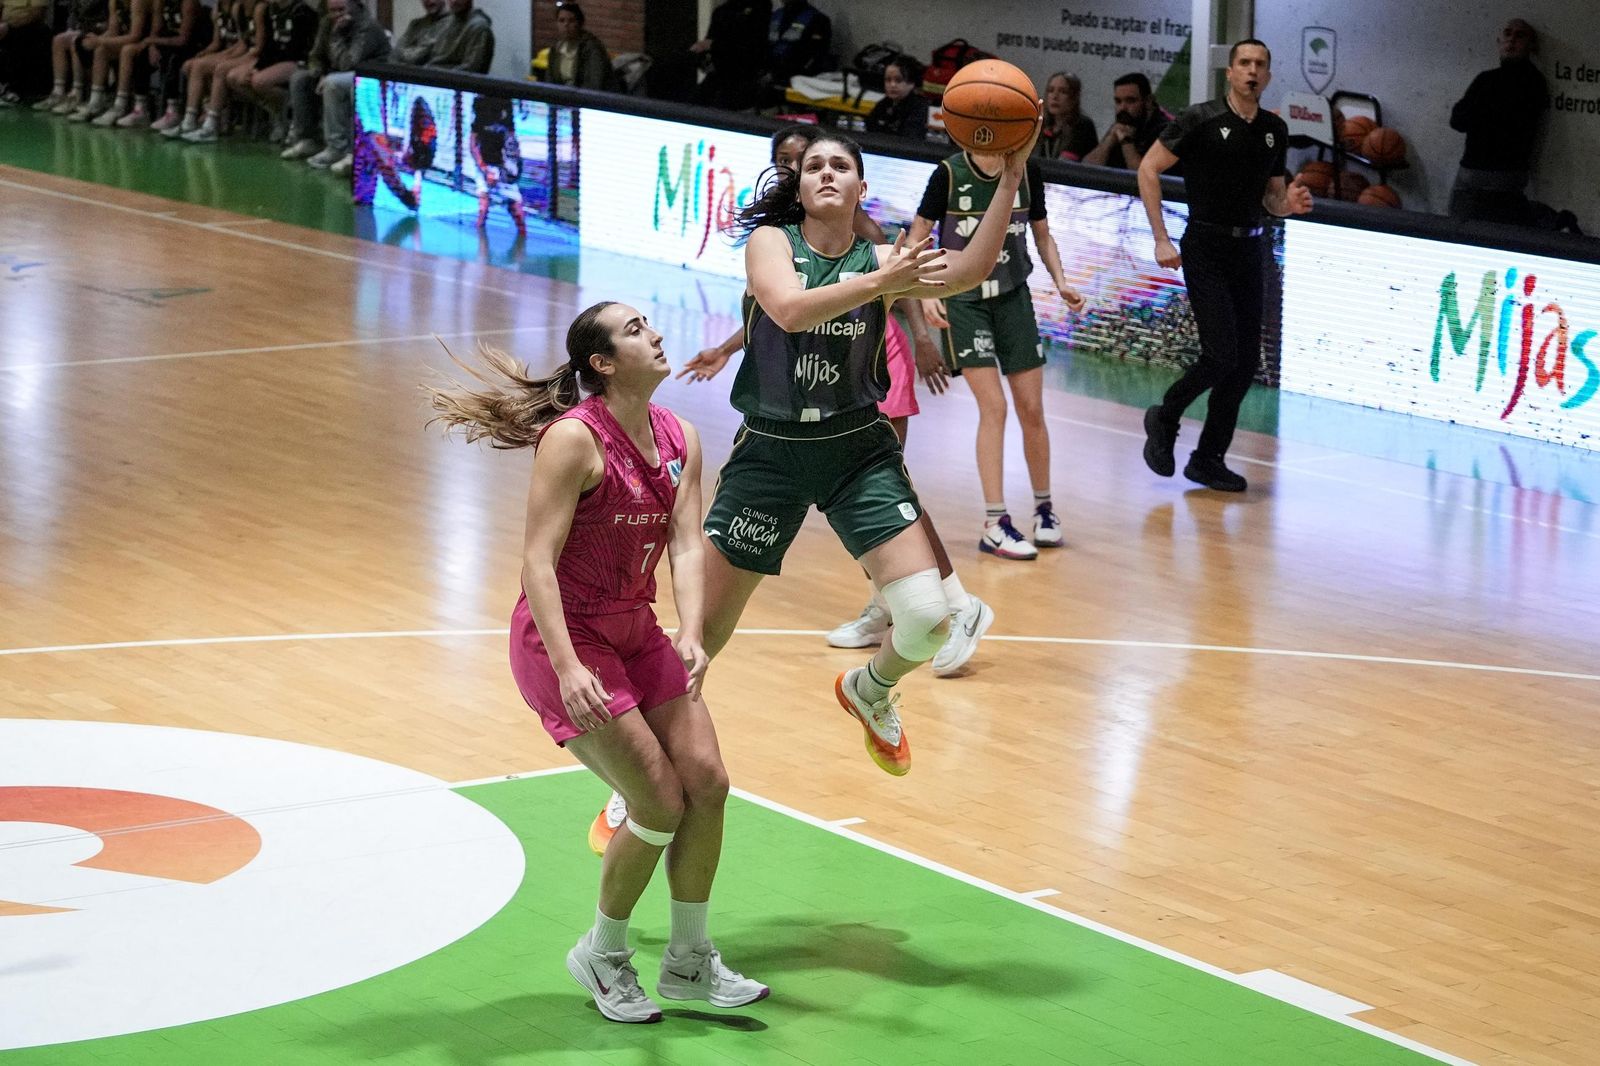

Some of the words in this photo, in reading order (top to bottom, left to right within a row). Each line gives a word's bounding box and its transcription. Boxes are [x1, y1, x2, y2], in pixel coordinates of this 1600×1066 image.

[1061, 9, 1099, 28] Puedo
[1101, 15, 1147, 35] aceptar
[1150, 18, 1161, 34] el
[1165, 18, 1192, 37] frac
[996, 32, 1023, 48] pero
[1025, 34, 1040, 49] no
[1043, 36, 1079, 52] puedo
[1081, 41, 1127, 60] aceptar
[1130, 46, 1146, 61] no
[1555, 61, 1572, 80] La
[1430, 266, 1600, 420] Mijas
[794, 352, 841, 391] Mijas
[742, 506, 779, 525] CLINICAS
[640, 542, 656, 574] 7
[727, 537, 763, 556] DENTAL
